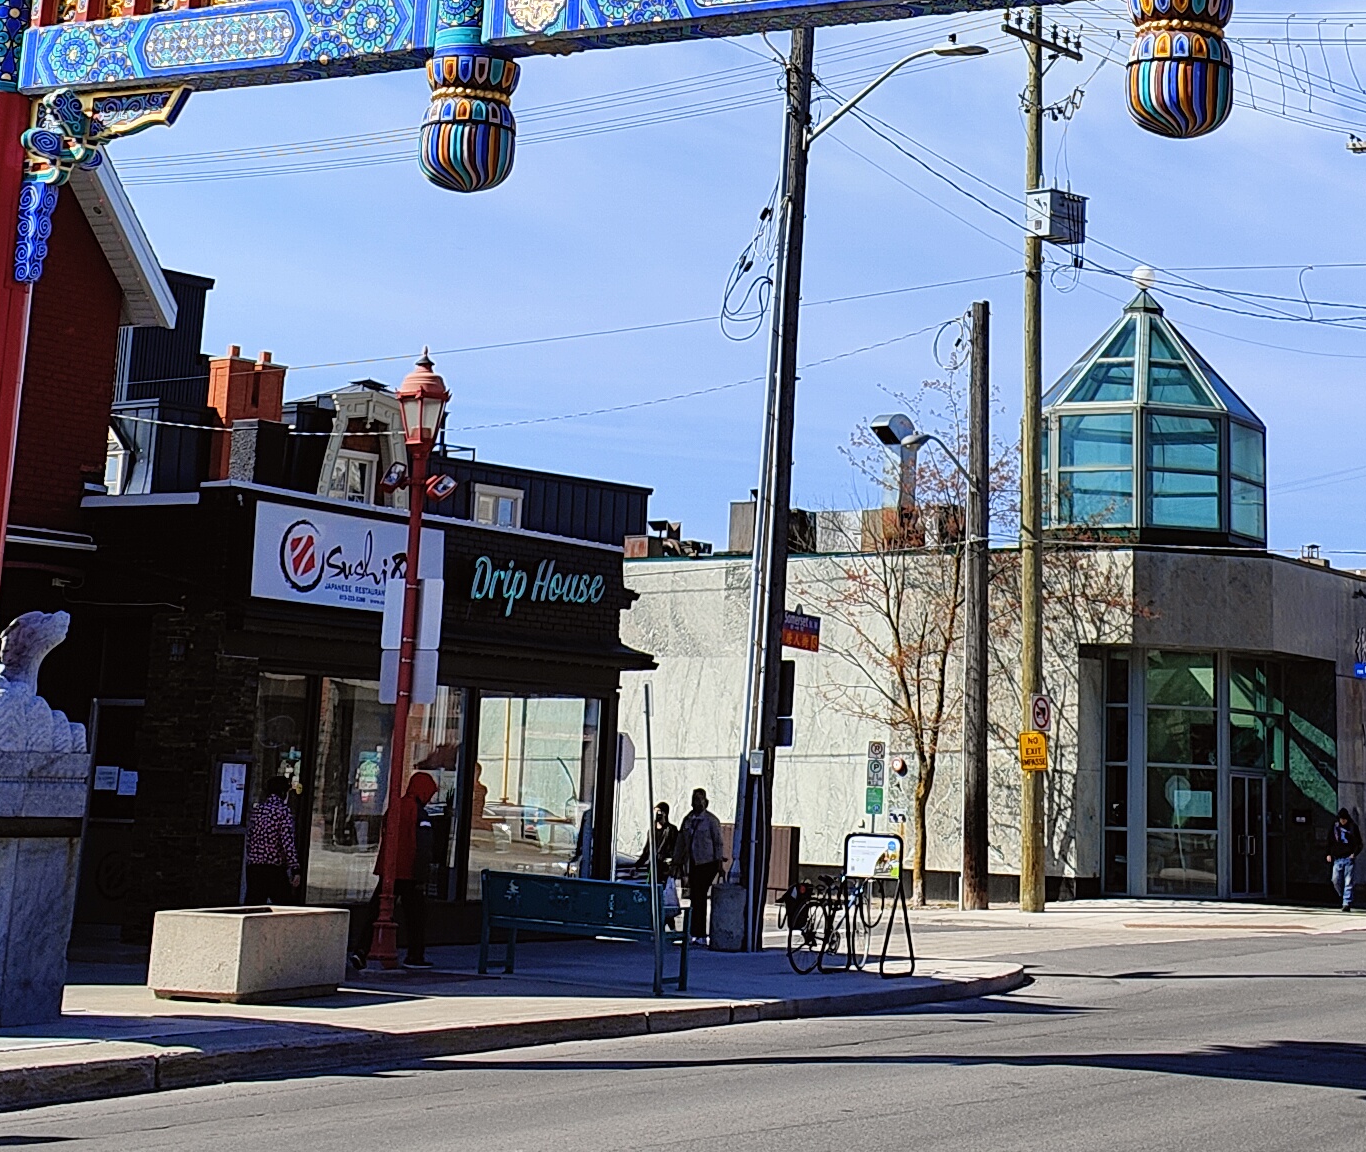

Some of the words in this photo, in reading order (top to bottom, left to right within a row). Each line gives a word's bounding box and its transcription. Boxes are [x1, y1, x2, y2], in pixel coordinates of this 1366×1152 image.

[326, 529, 388, 586] Sushi
[324, 582, 353, 593] JAPANESE
[354, 585, 386, 597] RESTAURAN
[470, 555, 528, 617] Drip
[530, 559, 606, 604] House
[784, 611, 809, 628] Somerset
[1027, 736, 1039, 745] NO
[1025, 747, 1042, 756] EXIT
[1022, 757, 1046, 766] IMPASSE
